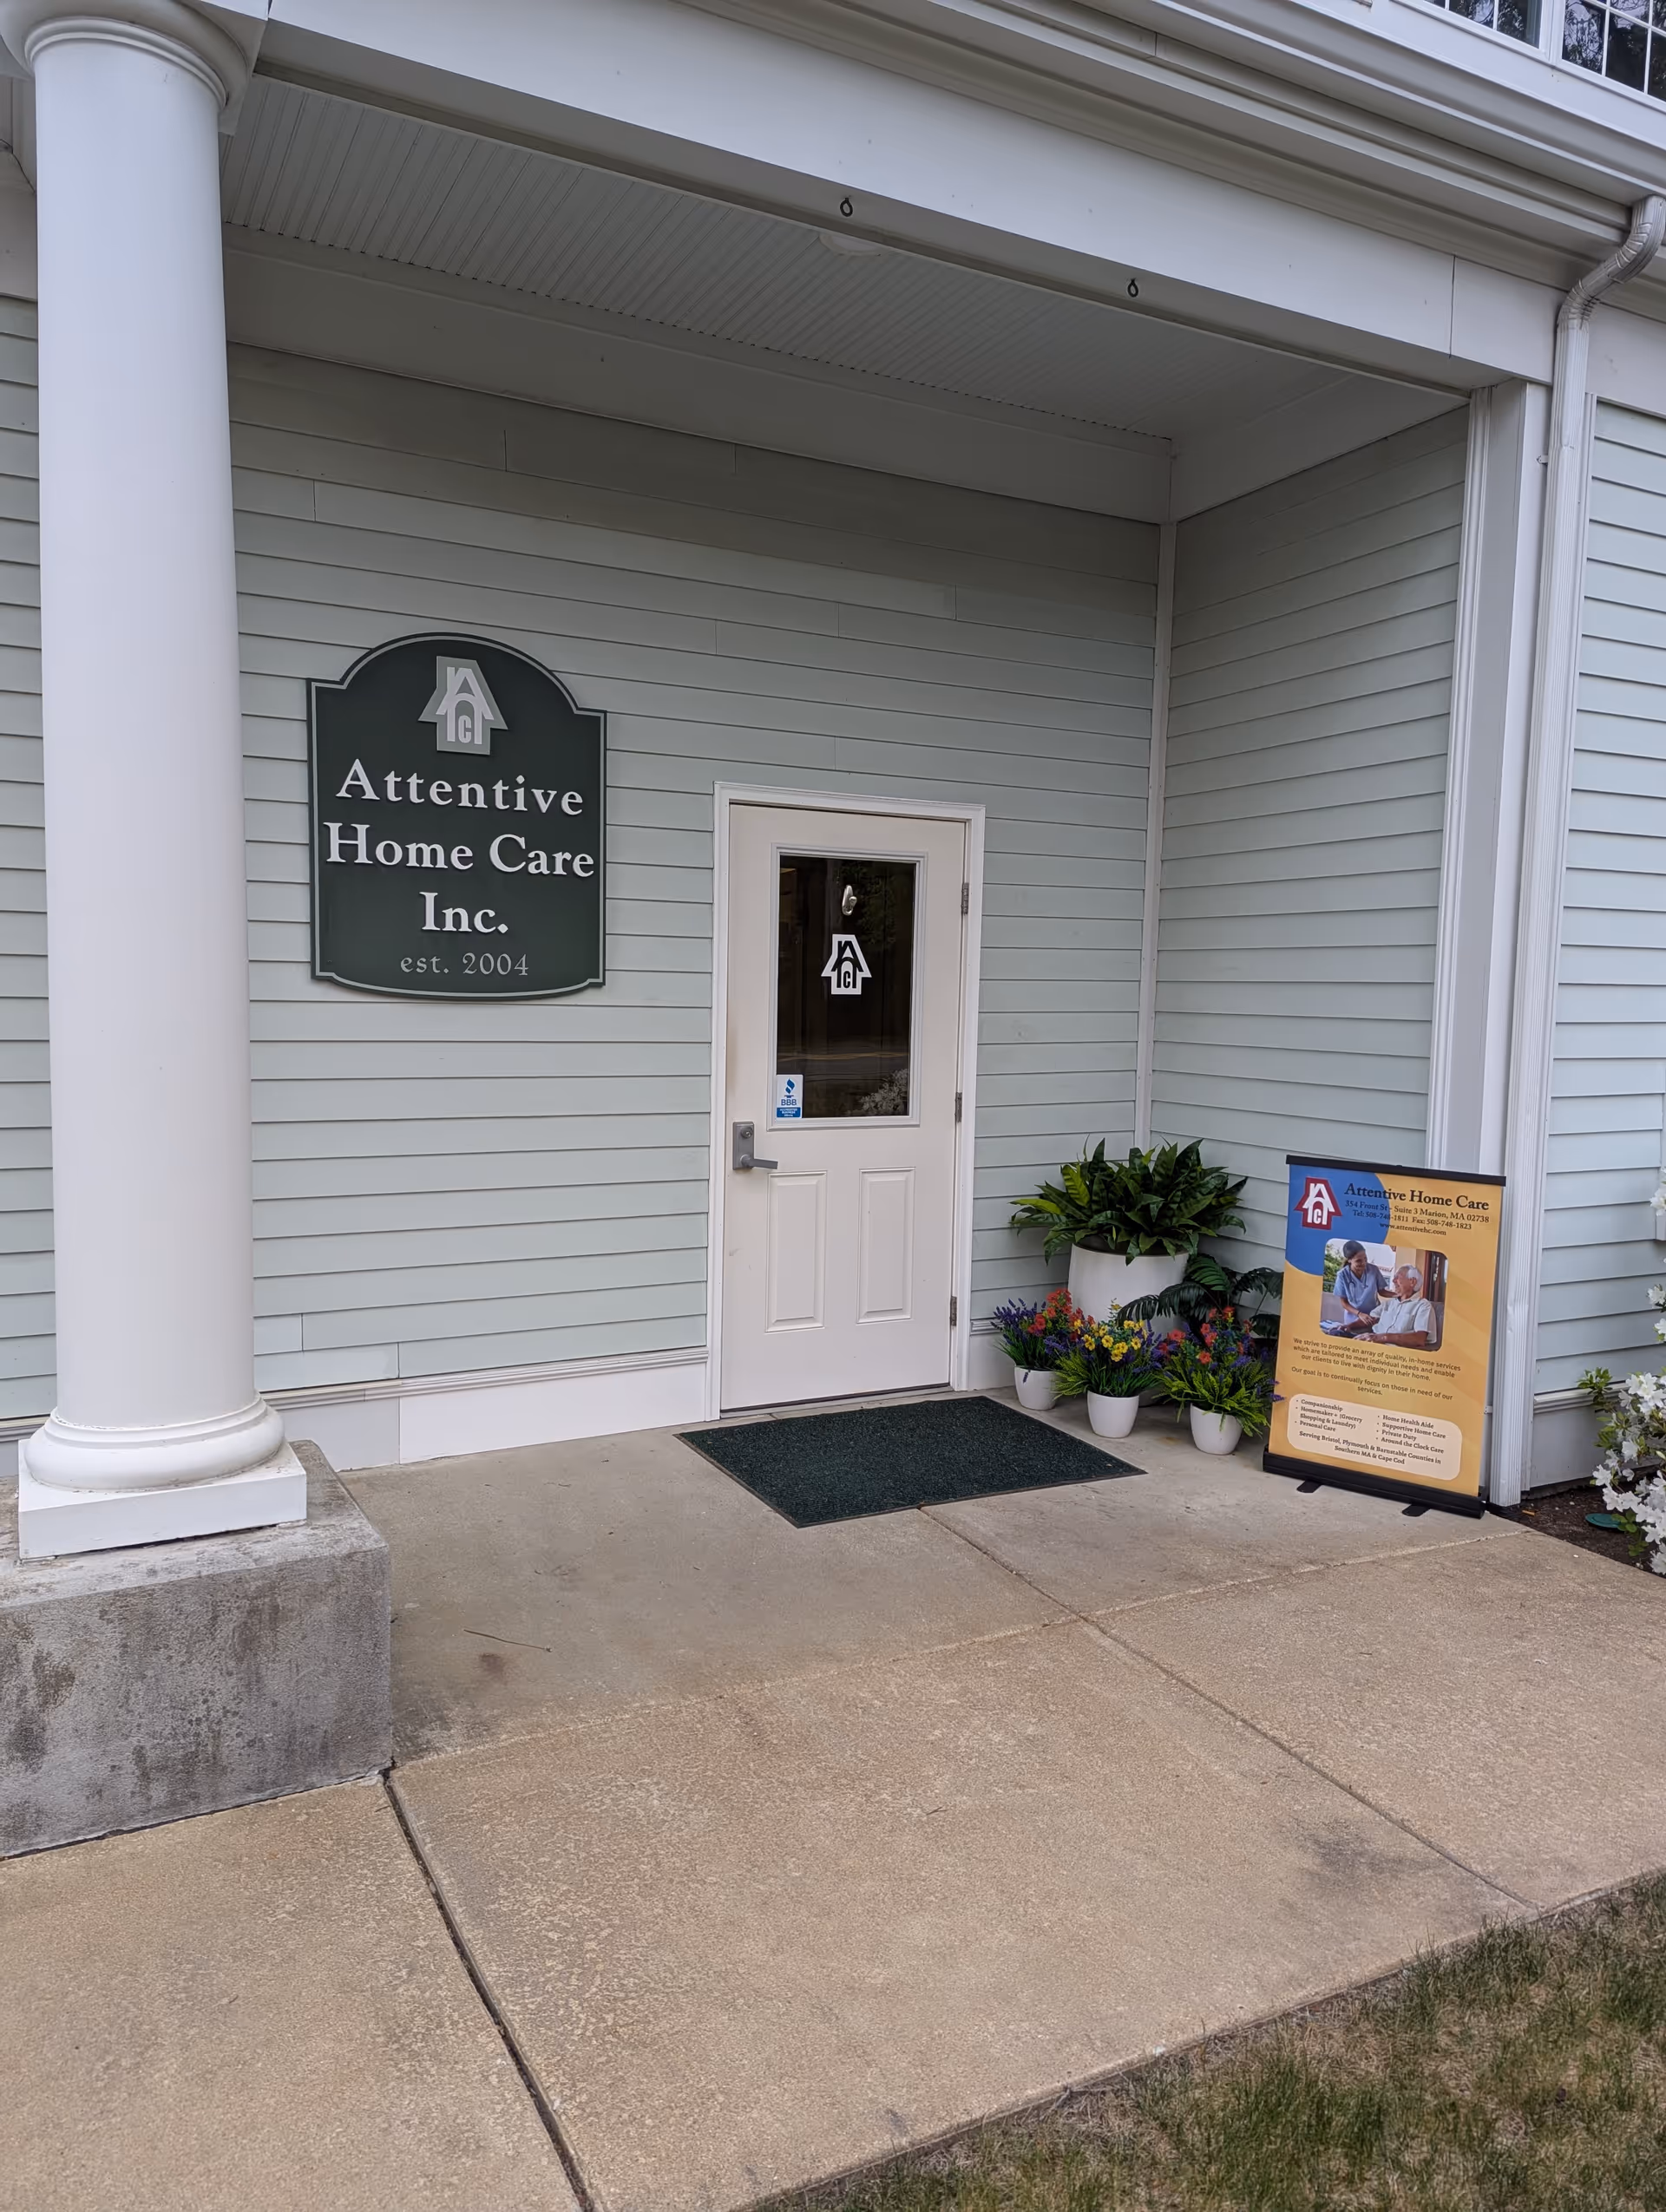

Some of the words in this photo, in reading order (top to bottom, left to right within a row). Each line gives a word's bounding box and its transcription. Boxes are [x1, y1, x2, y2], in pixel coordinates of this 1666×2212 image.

[335, 759, 584, 816] Attentive
[322, 822, 473, 871] Home
[489, 834, 594, 877] Care
[419, 891, 508, 934] Inc.
[400, 956, 449, 973] est.
[462, 952, 529, 976] 2004
[1344, 1183, 1406, 1201] Attentive
[1409, 1190, 1452, 1206] Home
[1456, 1195, 1489, 1210] Care
[1360, 1201, 1378, 1210] Front
[1394, 1206, 1412, 1214] Suite
[1420, 1209, 1449, 1219] Marion,
[1450, 1212, 1465, 1220] MA
[1467, 1214, 1489, 1223] 02738
[1366, 1212, 1408, 1222] 508-748-1811
[1427, 1219, 1471, 1229] 508-748-1823
[1380, 1223, 1446, 1235] www.attentivehc.com
[1322, 1350, 1344, 1358] tailored
[1370, 1357, 1399, 1368] individual
[1434, 1369, 1455, 1378] enable
[1328, 1344, 1350, 1352] provide
[1385, 1353, 1407, 1363] quality,
[1409, 1358, 1434, 1367] in-home
[1436, 1362, 1461, 1371] services
[1313, 1355, 1332, 1363] clients
[1367, 1364, 1387, 1374] dignity
[1412, 1372, 1430, 1381] home.
[1331, 1374, 1363, 1385] continually
[1357, 1386, 1383, 1395] services.
[1301, 1399, 1343, 1412] Companionship
[1301, 1406, 1334, 1417] Homemaker
[1300, 1414, 1325, 1423] Shopping
[1300, 1421, 1322, 1429] Personal
[1382, 1423, 1413, 1432] Supportive
[1415, 1428, 1432, 1436] Home
[1382, 1429, 1401, 1438] Private
[1299, 1431, 1320, 1440] Serving
[1322, 1436, 1341, 1444] Bristol,
[1342, 1440, 1369, 1450] Plymouth
[1376, 1446, 1407, 1457] Barnstable
[1408, 1453, 1434, 1463] Counties
[1381, 1437, 1402, 1445] Around
[1335, 1446, 1360, 1455] Southern
